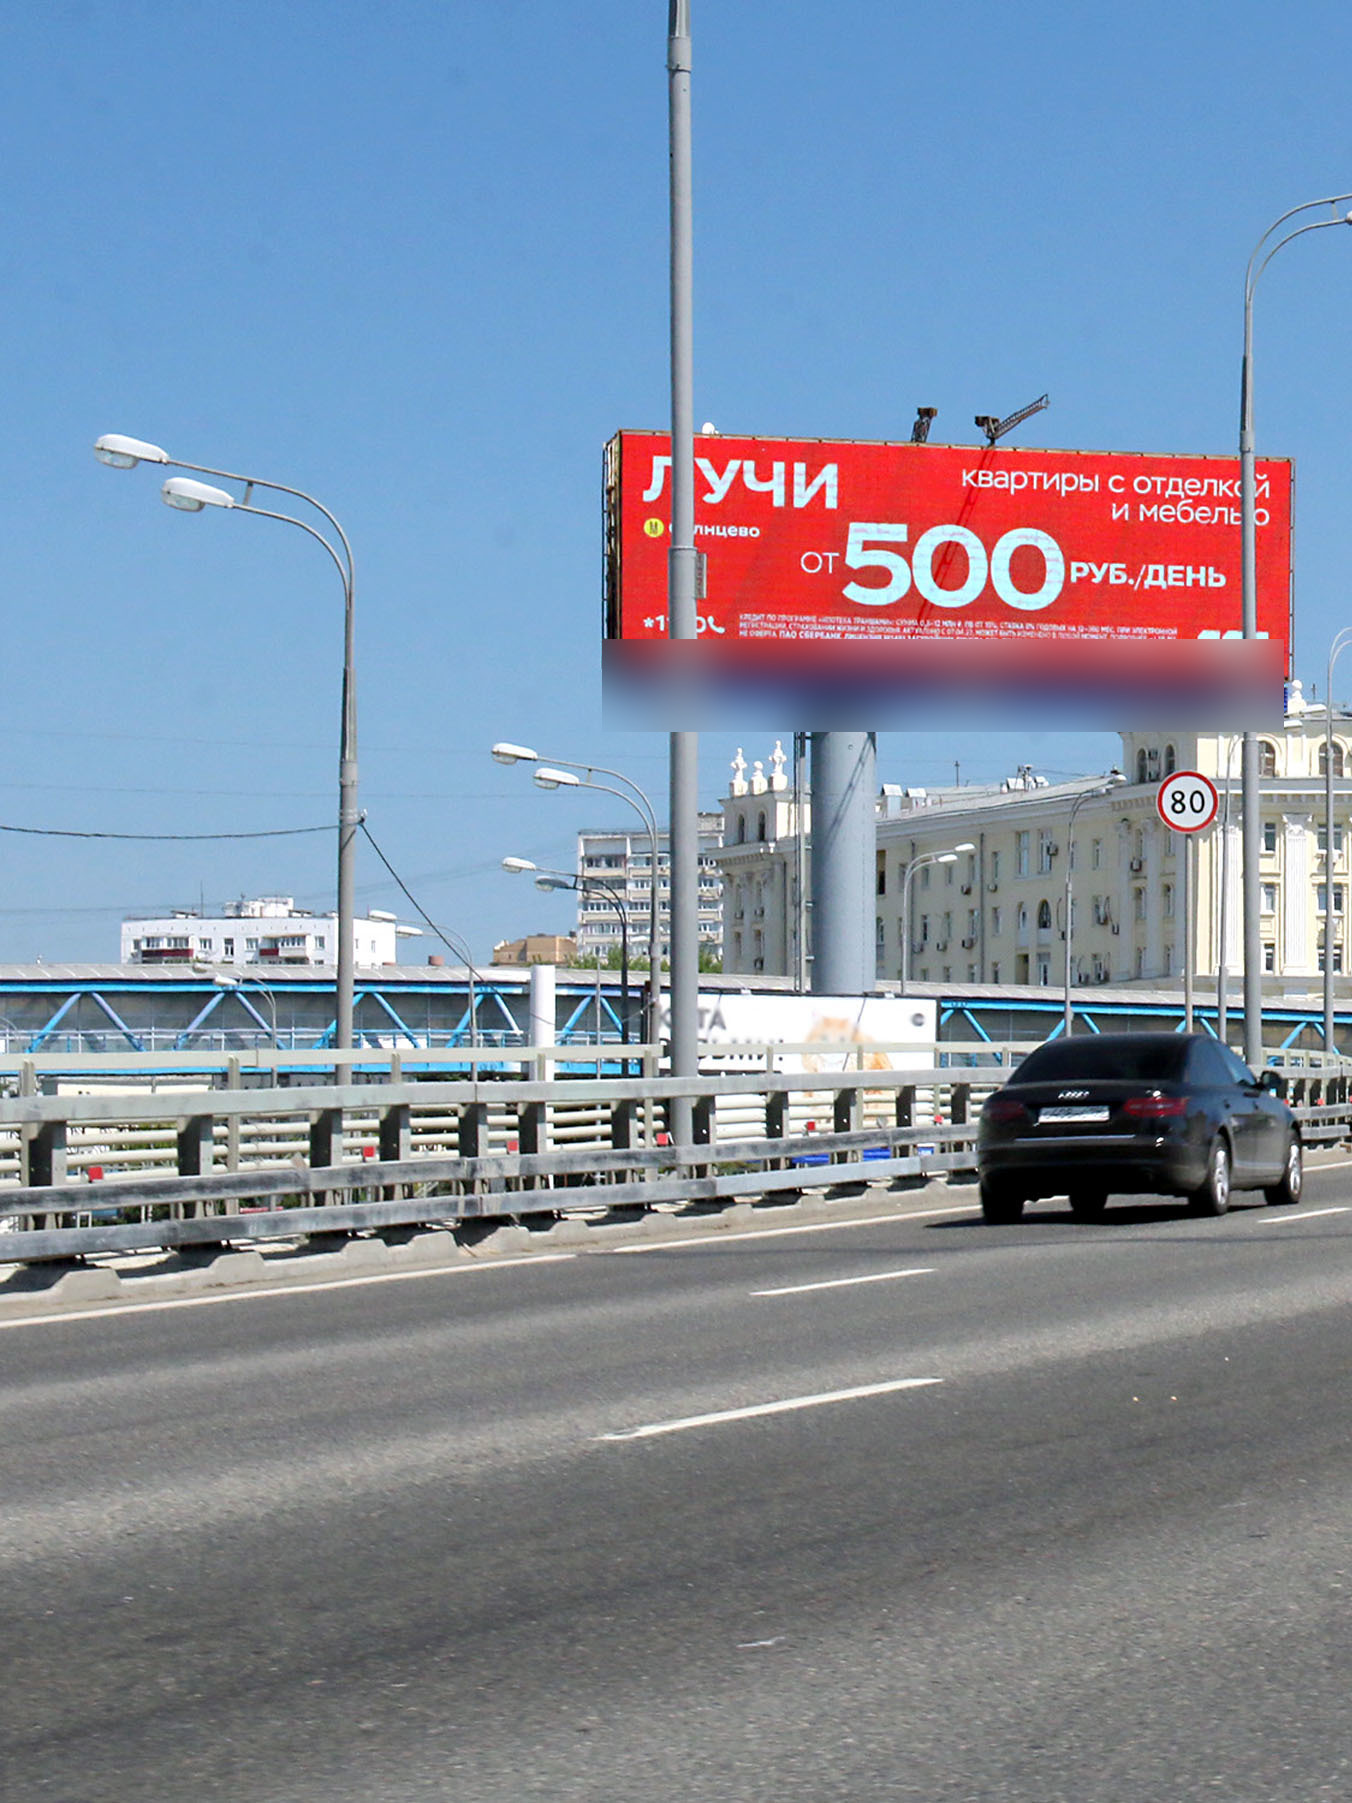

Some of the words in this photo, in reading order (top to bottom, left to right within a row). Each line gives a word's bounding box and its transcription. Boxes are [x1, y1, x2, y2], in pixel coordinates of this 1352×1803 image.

[642, 455, 839, 510] ЛУЧИ
[962, 468, 1099, 498] квартиры
[1108, 474, 1125, 493] с
[1112, 504, 1129, 521] и
[669, 523, 760, 538] лнцево
[842, 522, 1066, 611] 500
[1070, 561, 1227, 591] РУБ./ДЕНЬ
[1171, 790, 1205, 814] 80
